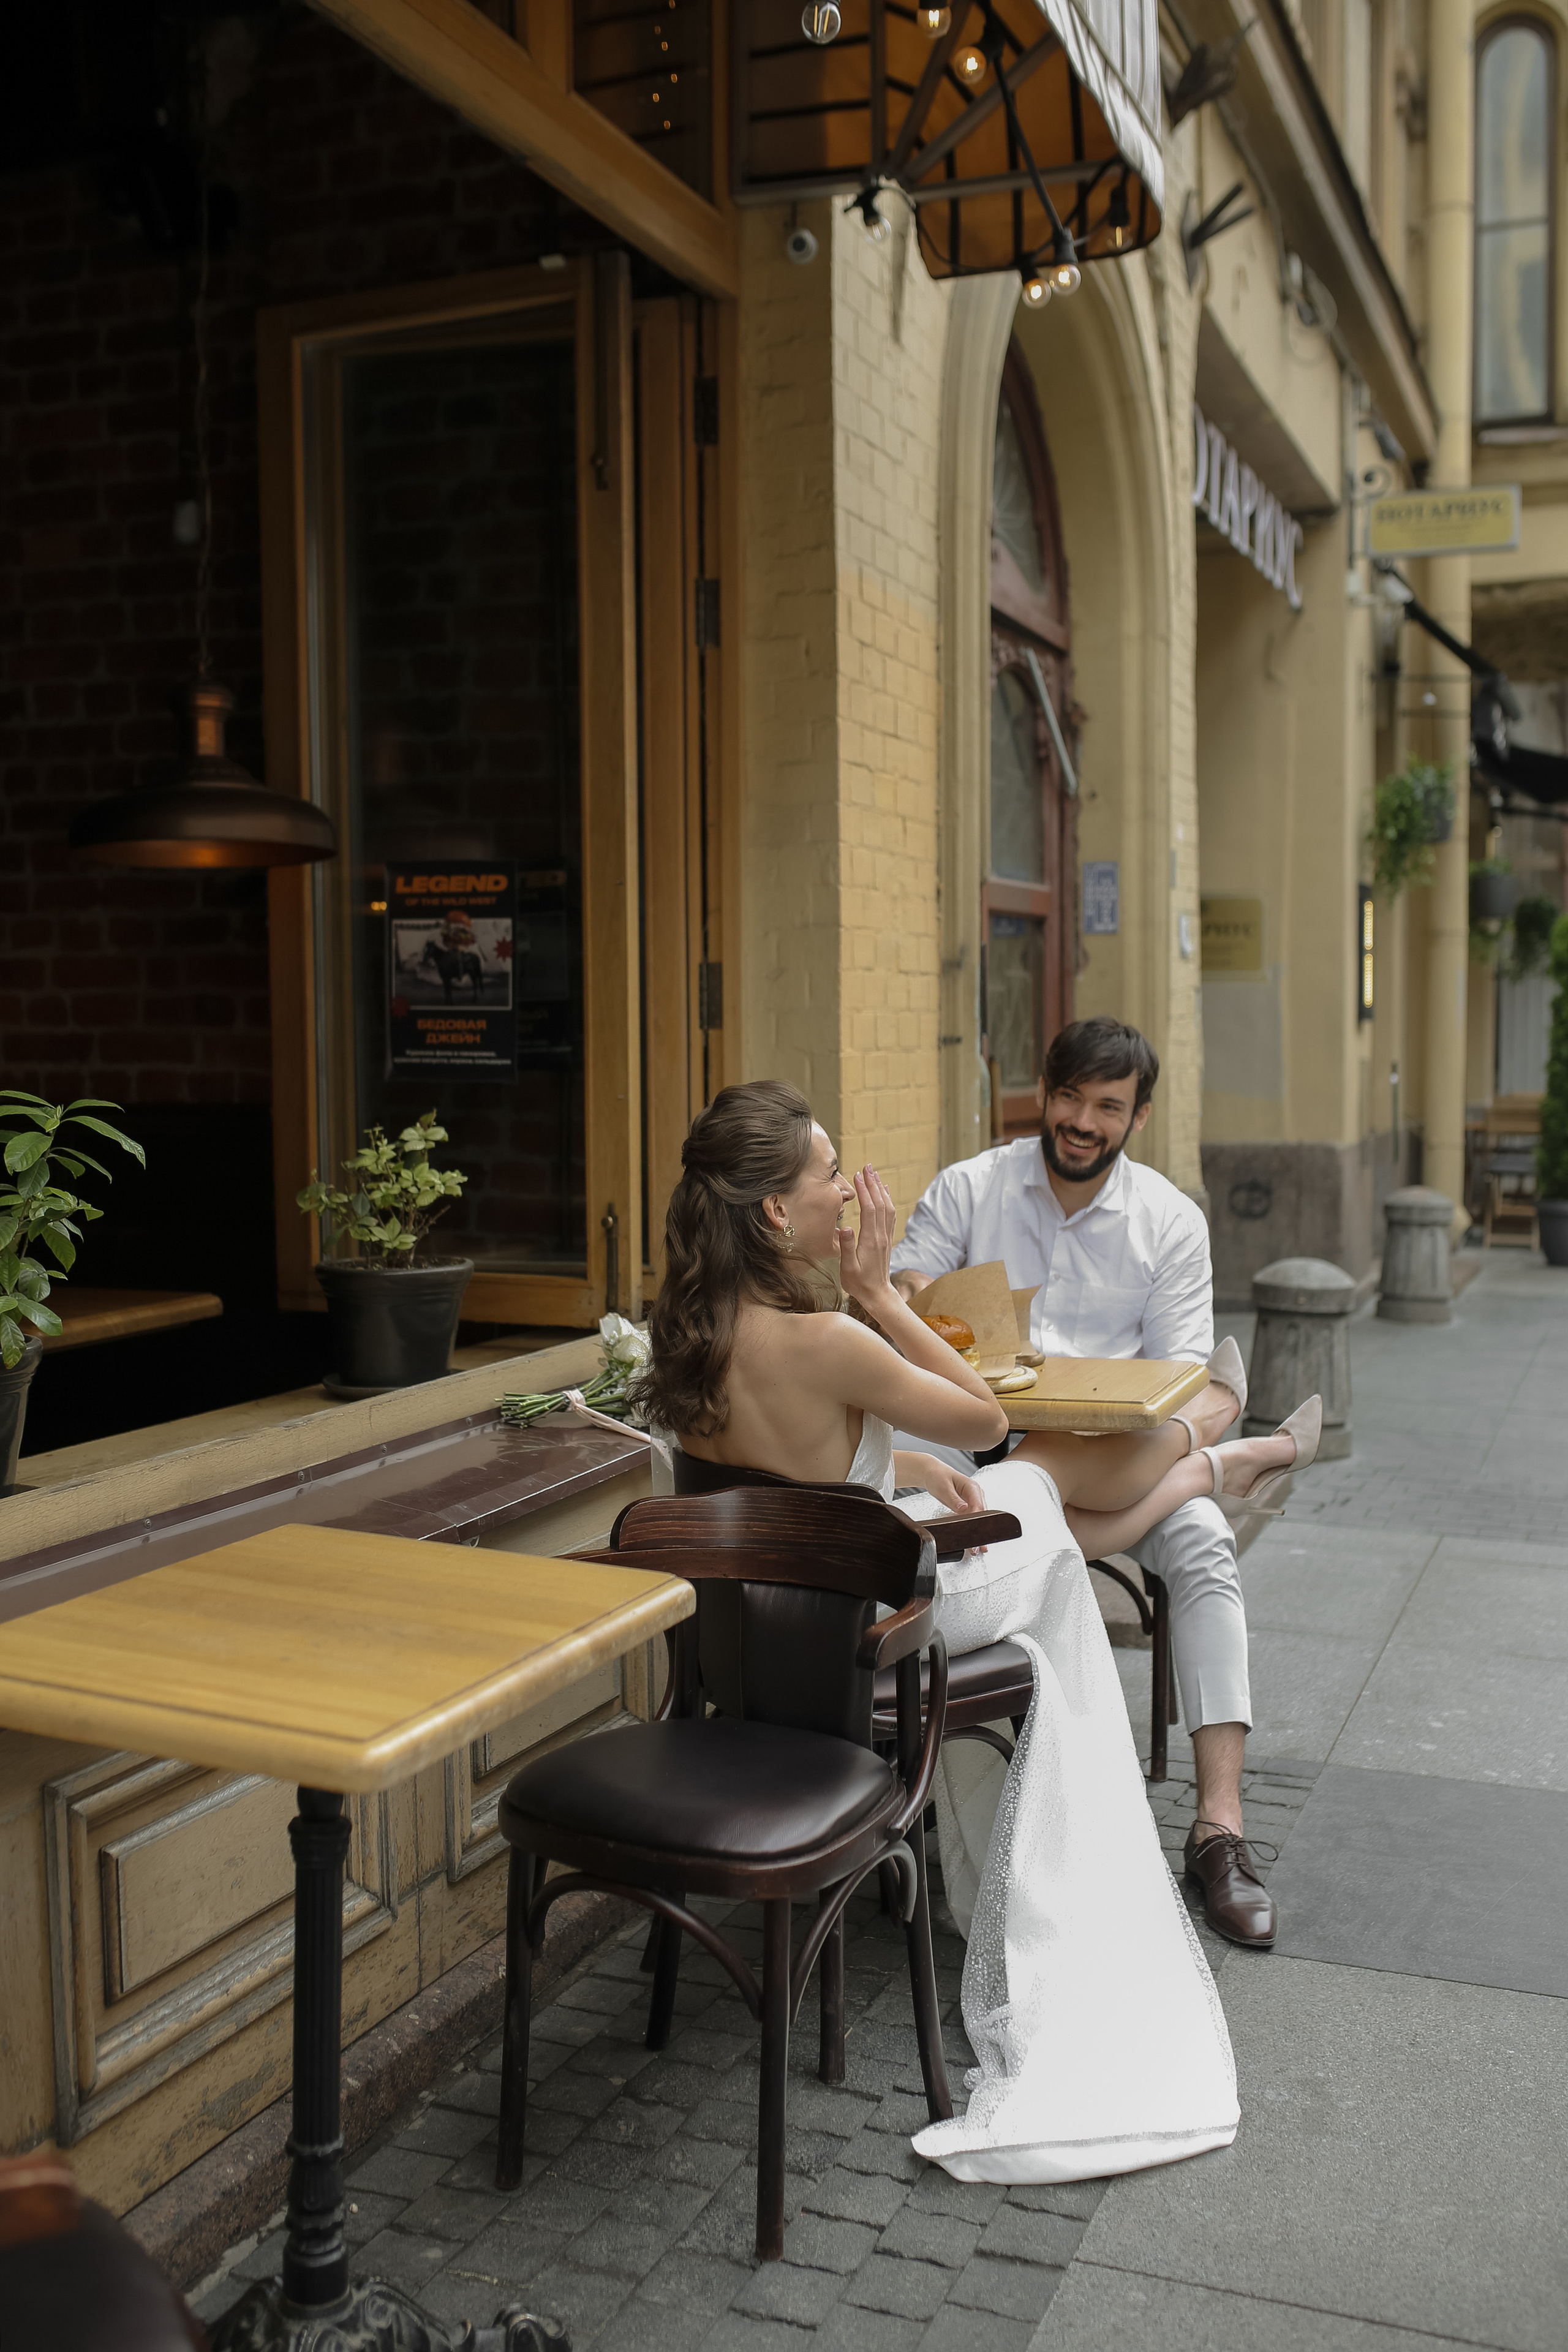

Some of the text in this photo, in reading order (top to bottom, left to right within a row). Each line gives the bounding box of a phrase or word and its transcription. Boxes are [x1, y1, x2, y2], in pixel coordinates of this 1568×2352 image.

[396, 873, 508, 894] LEGEND
[405, 895, 497, 907] OF THE WILD WEST
[417, 1019, 486, 1031] БЕДОВАЯ
[426, 1032, 481, 1044] ДЖЕЙН
